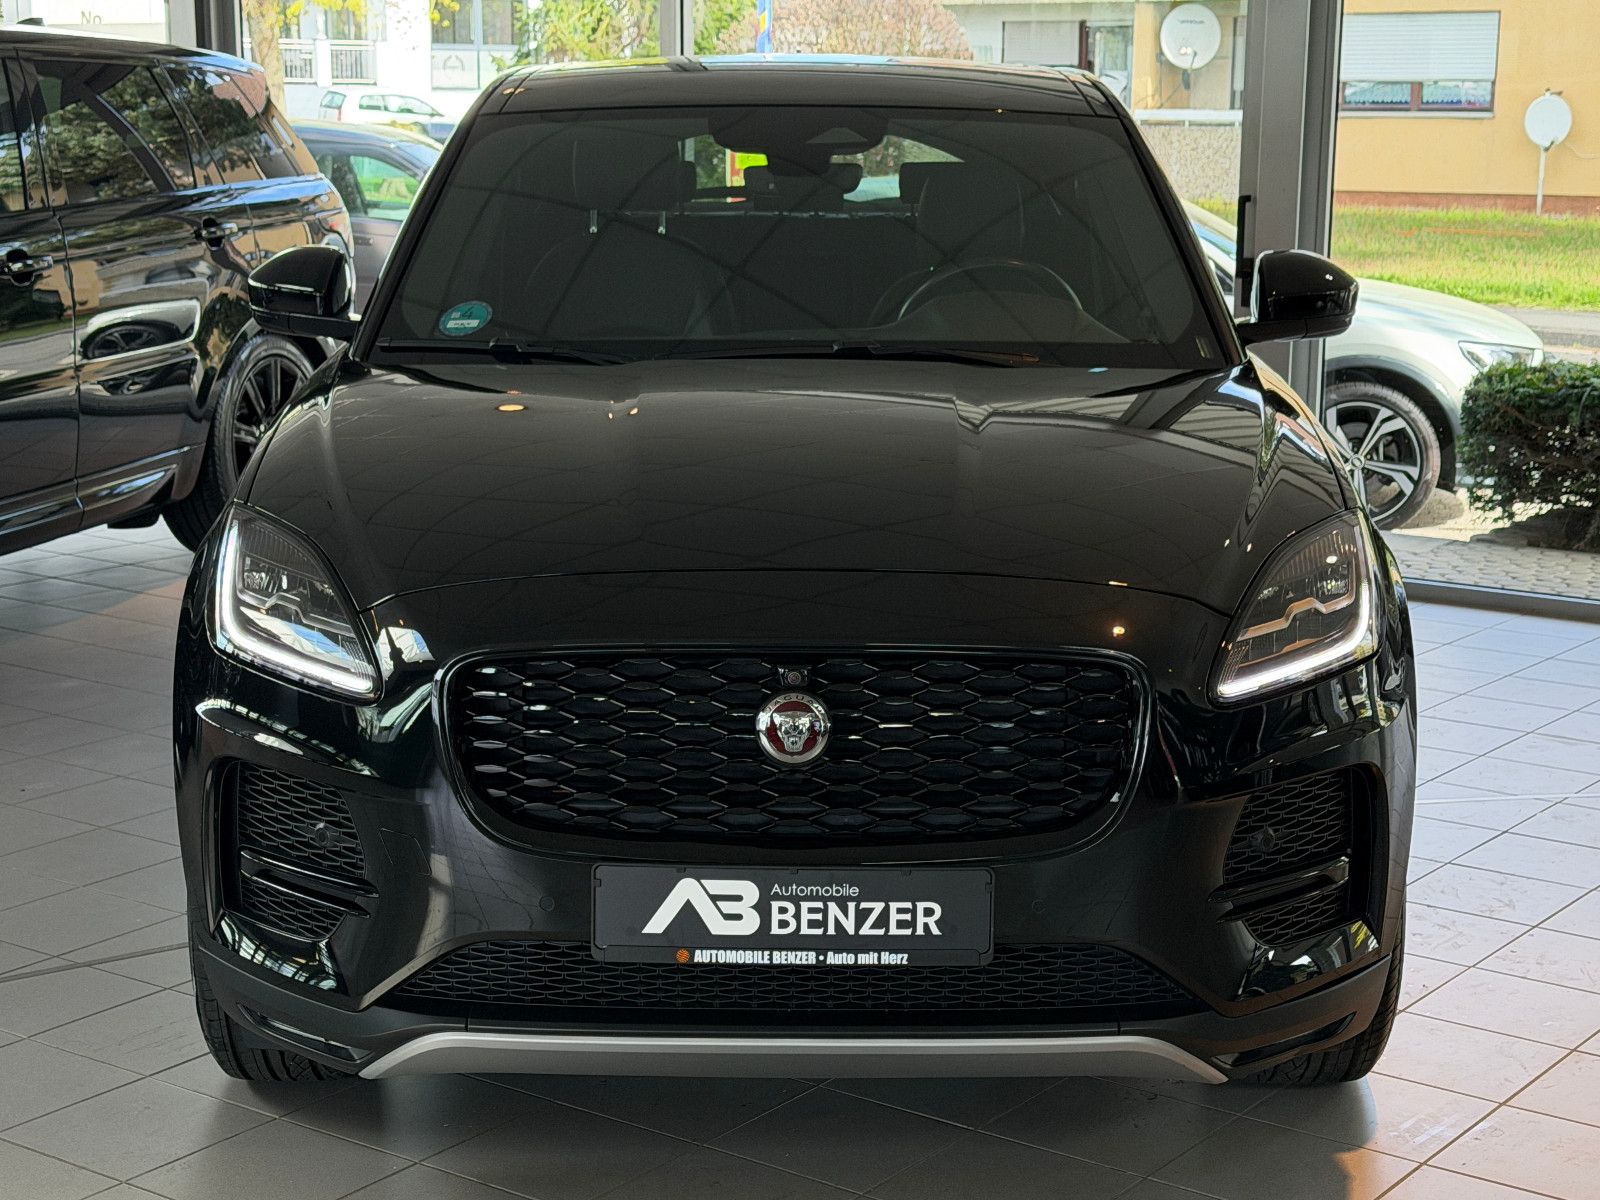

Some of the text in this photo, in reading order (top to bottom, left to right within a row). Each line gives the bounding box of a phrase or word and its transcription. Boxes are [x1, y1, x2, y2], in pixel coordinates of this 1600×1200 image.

[770, 883, 860, 897] Automobile
[769, 900, 943, 936] BENZER
[693, 949, 909, 965] AUTOMOBILE BENZER Auto mit Herz
